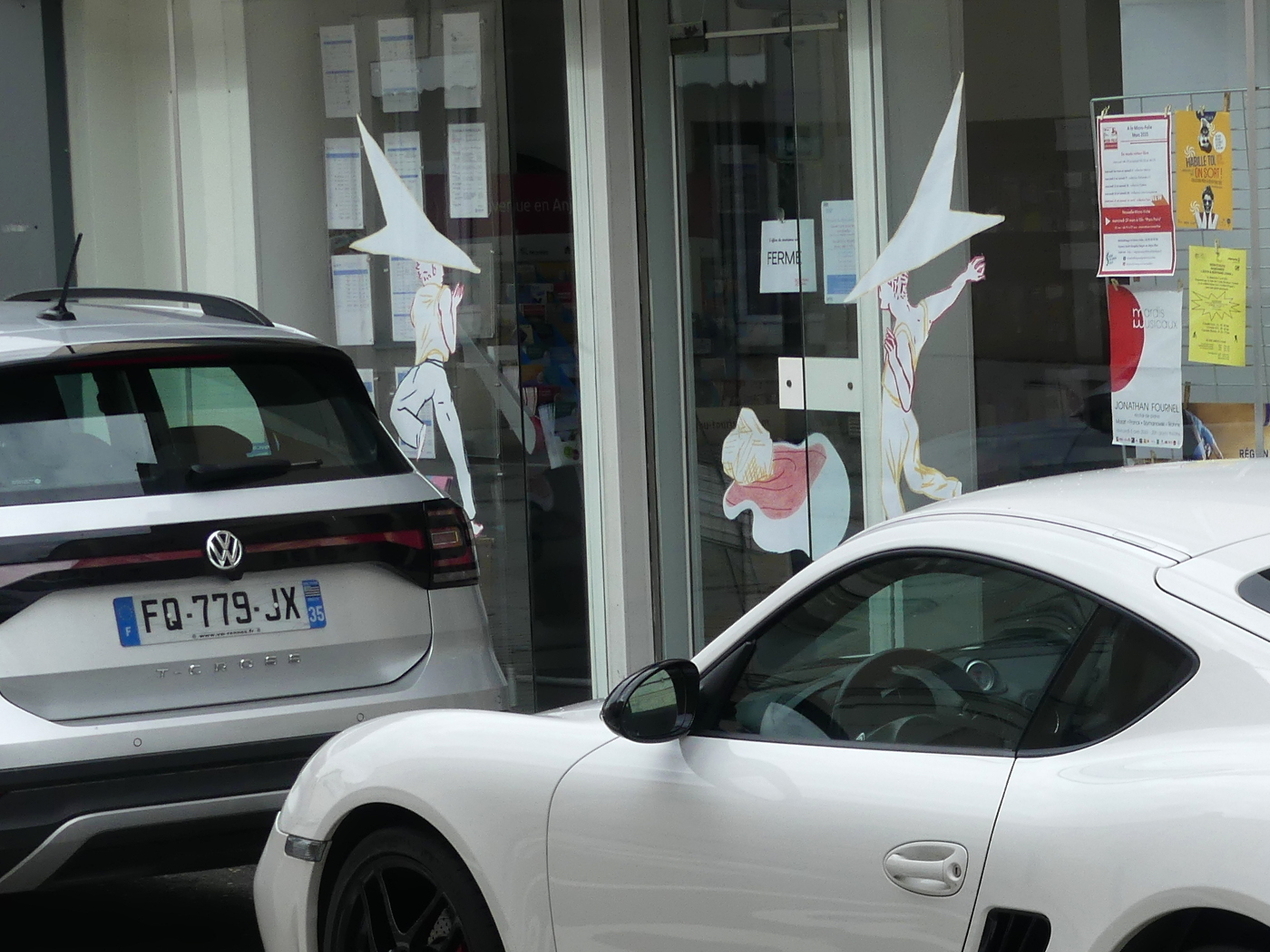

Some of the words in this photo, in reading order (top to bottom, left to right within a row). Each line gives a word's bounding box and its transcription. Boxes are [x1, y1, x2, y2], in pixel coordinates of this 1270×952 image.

[1115, 401, 1149, 411] JONATHAN
[1152, 403, 1179, 413] FOURNEL
[1240, 448, 1268, 458] RÉGN
[308, 606, 324, 622] 35
[125, 626, 131, 636] F
